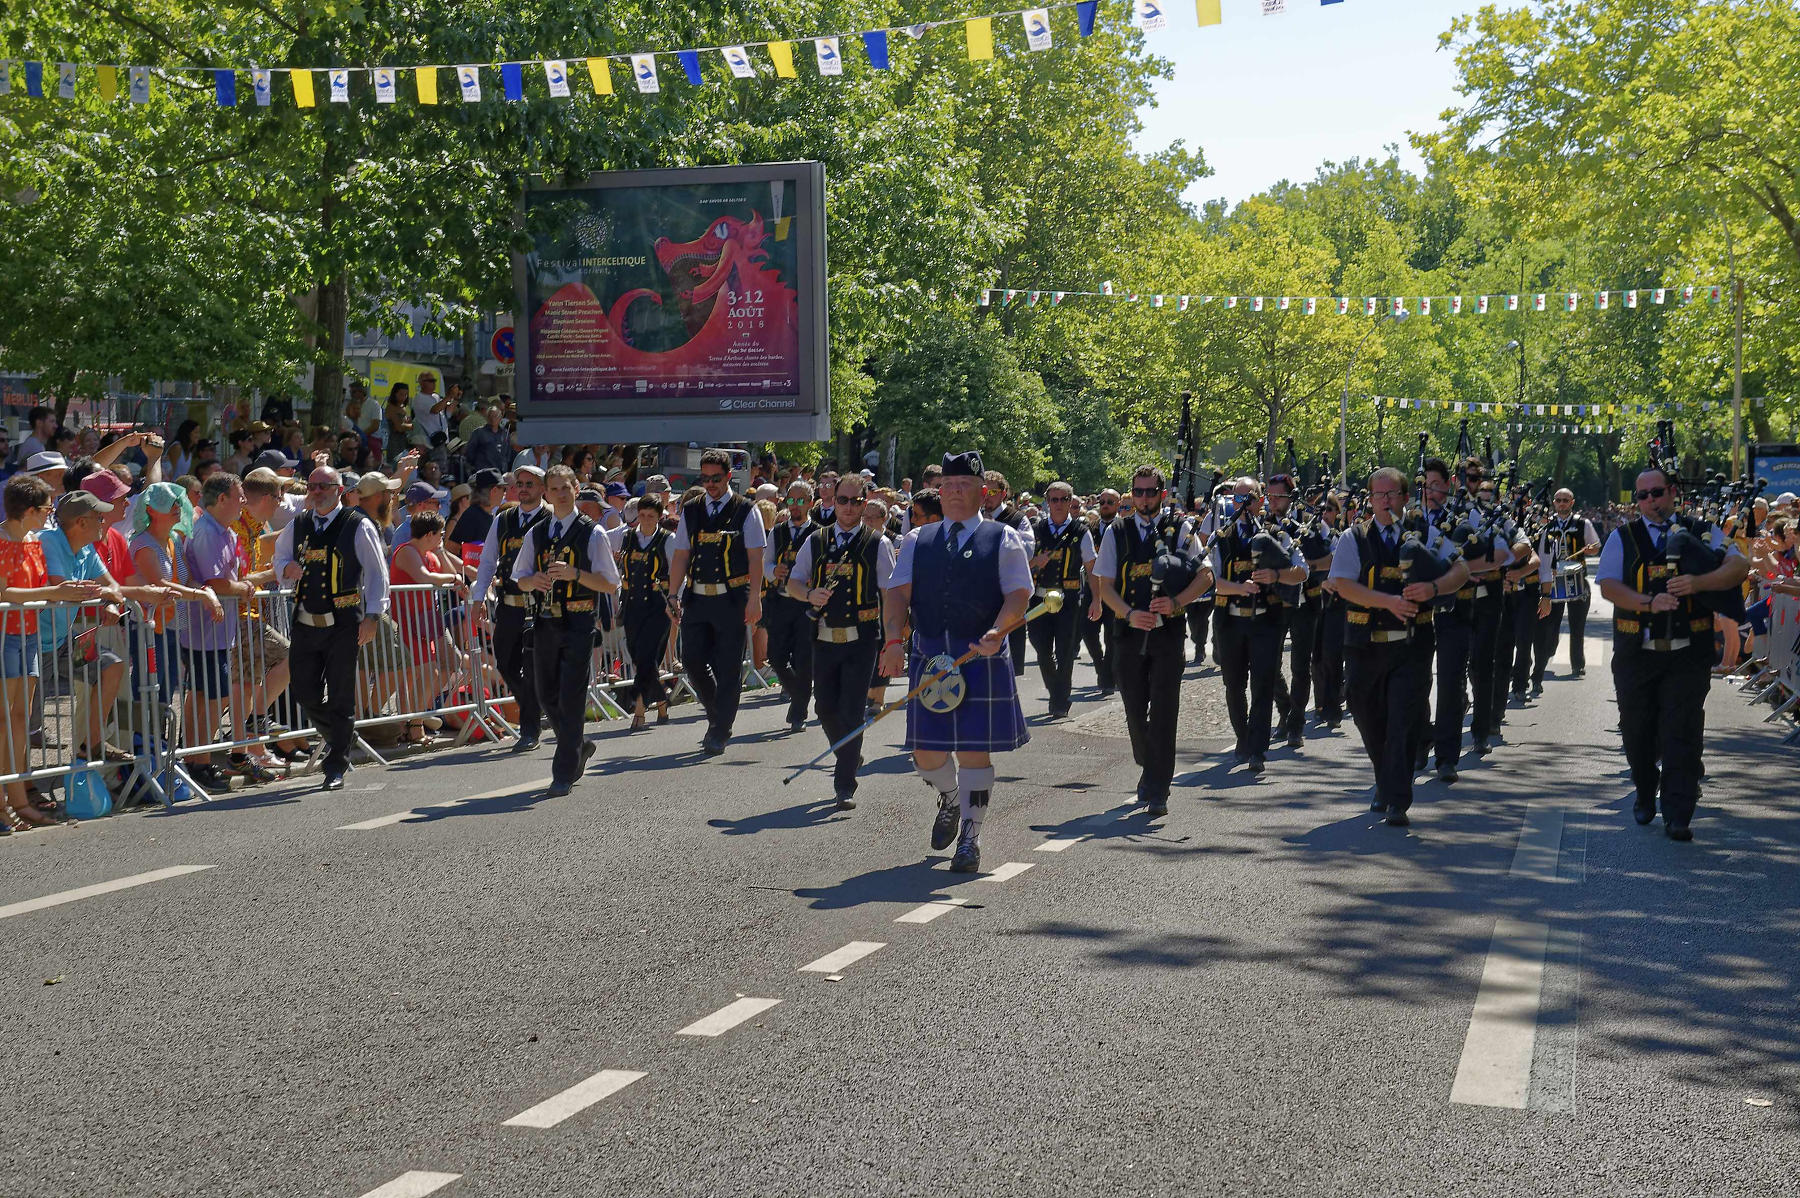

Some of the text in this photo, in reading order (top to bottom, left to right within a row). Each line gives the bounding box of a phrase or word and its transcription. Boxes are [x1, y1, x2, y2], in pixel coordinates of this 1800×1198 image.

[582, 256, 646, 267] INTERCELTIQUE
[727, 290, 764, 305] 3-12
[727, 305, 765, 318] AOÛT
[727, 320, 765, 329] 2018
[733, 398, 796, 409] Clear Channel
